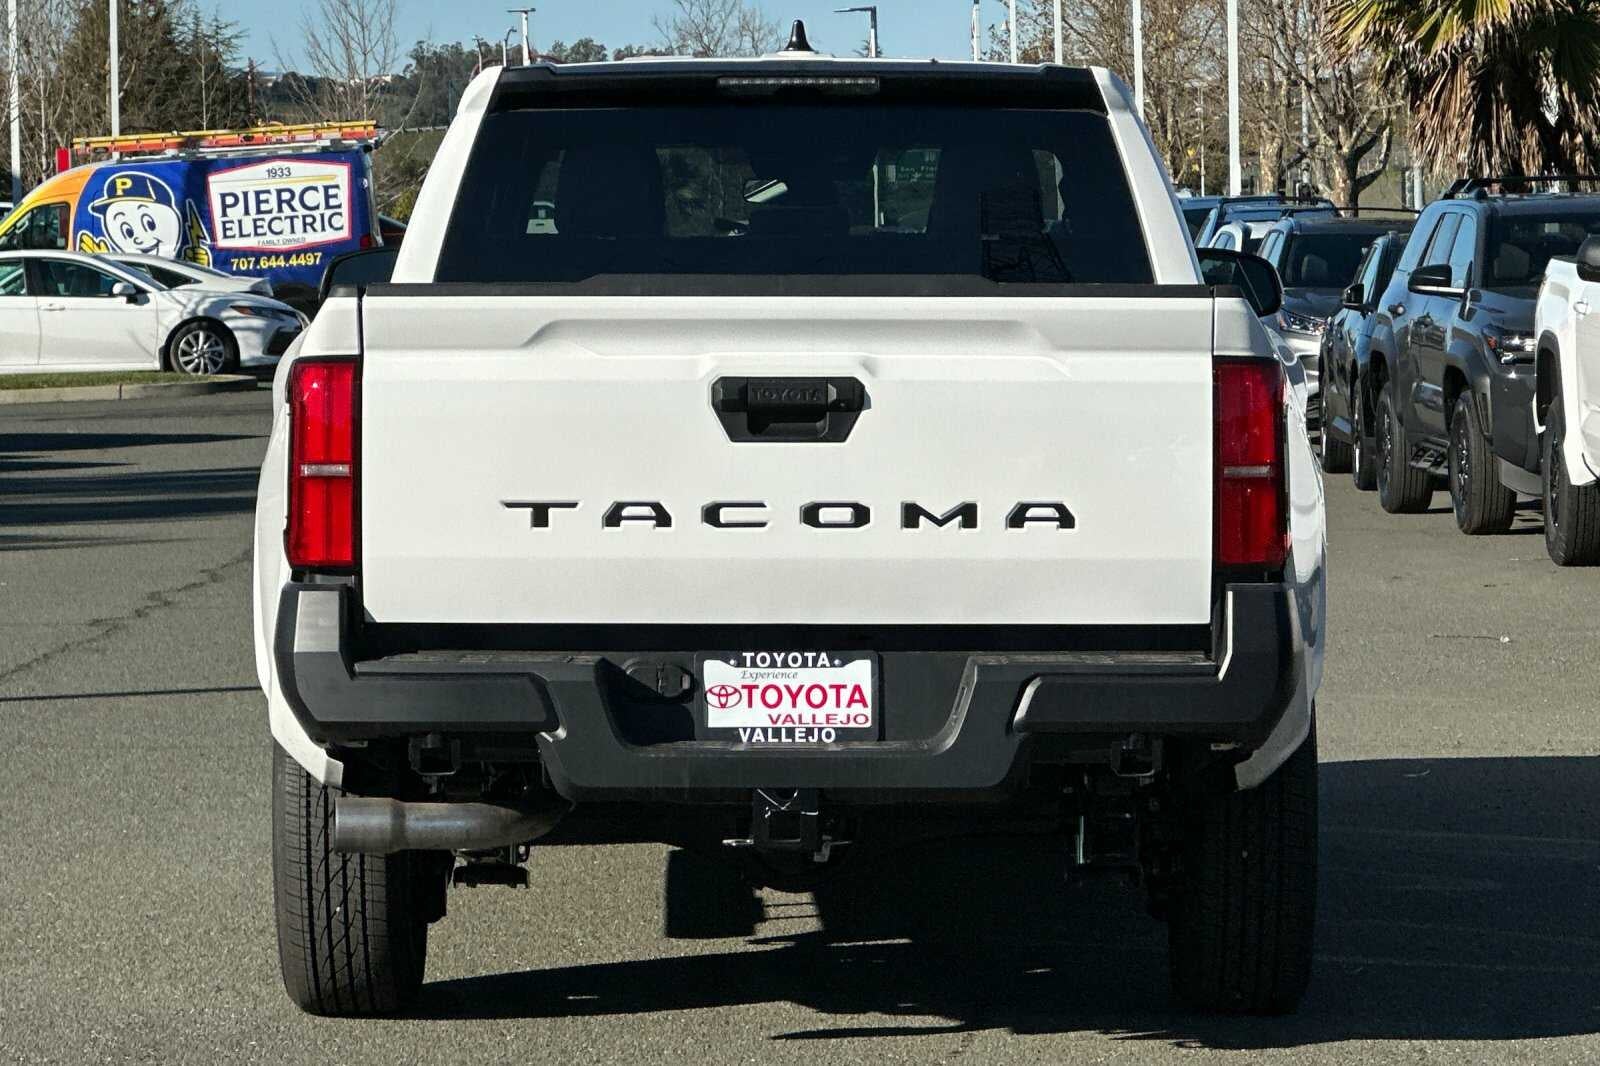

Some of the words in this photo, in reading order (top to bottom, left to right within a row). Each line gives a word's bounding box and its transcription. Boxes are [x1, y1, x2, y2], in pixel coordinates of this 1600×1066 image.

[266, 167, 291, 178] 1933
[115, 177, 133, 196] P
[219, 184, 342, 218] PIERCE
[221, 212, 344, 239] ELECTRIC
[231, 252, 322, 271] 707.644.4497
[500, 500, 1077, 530] TACOMA
[742, 652, 831, 668] TOYOTA
[741, 670, 798, 681] Experience
[741, 684, 869, 709] TOYOTA
[768, 713, 869, 725] VALLEJO
[739, 727, 836, 743] VALLEJO
